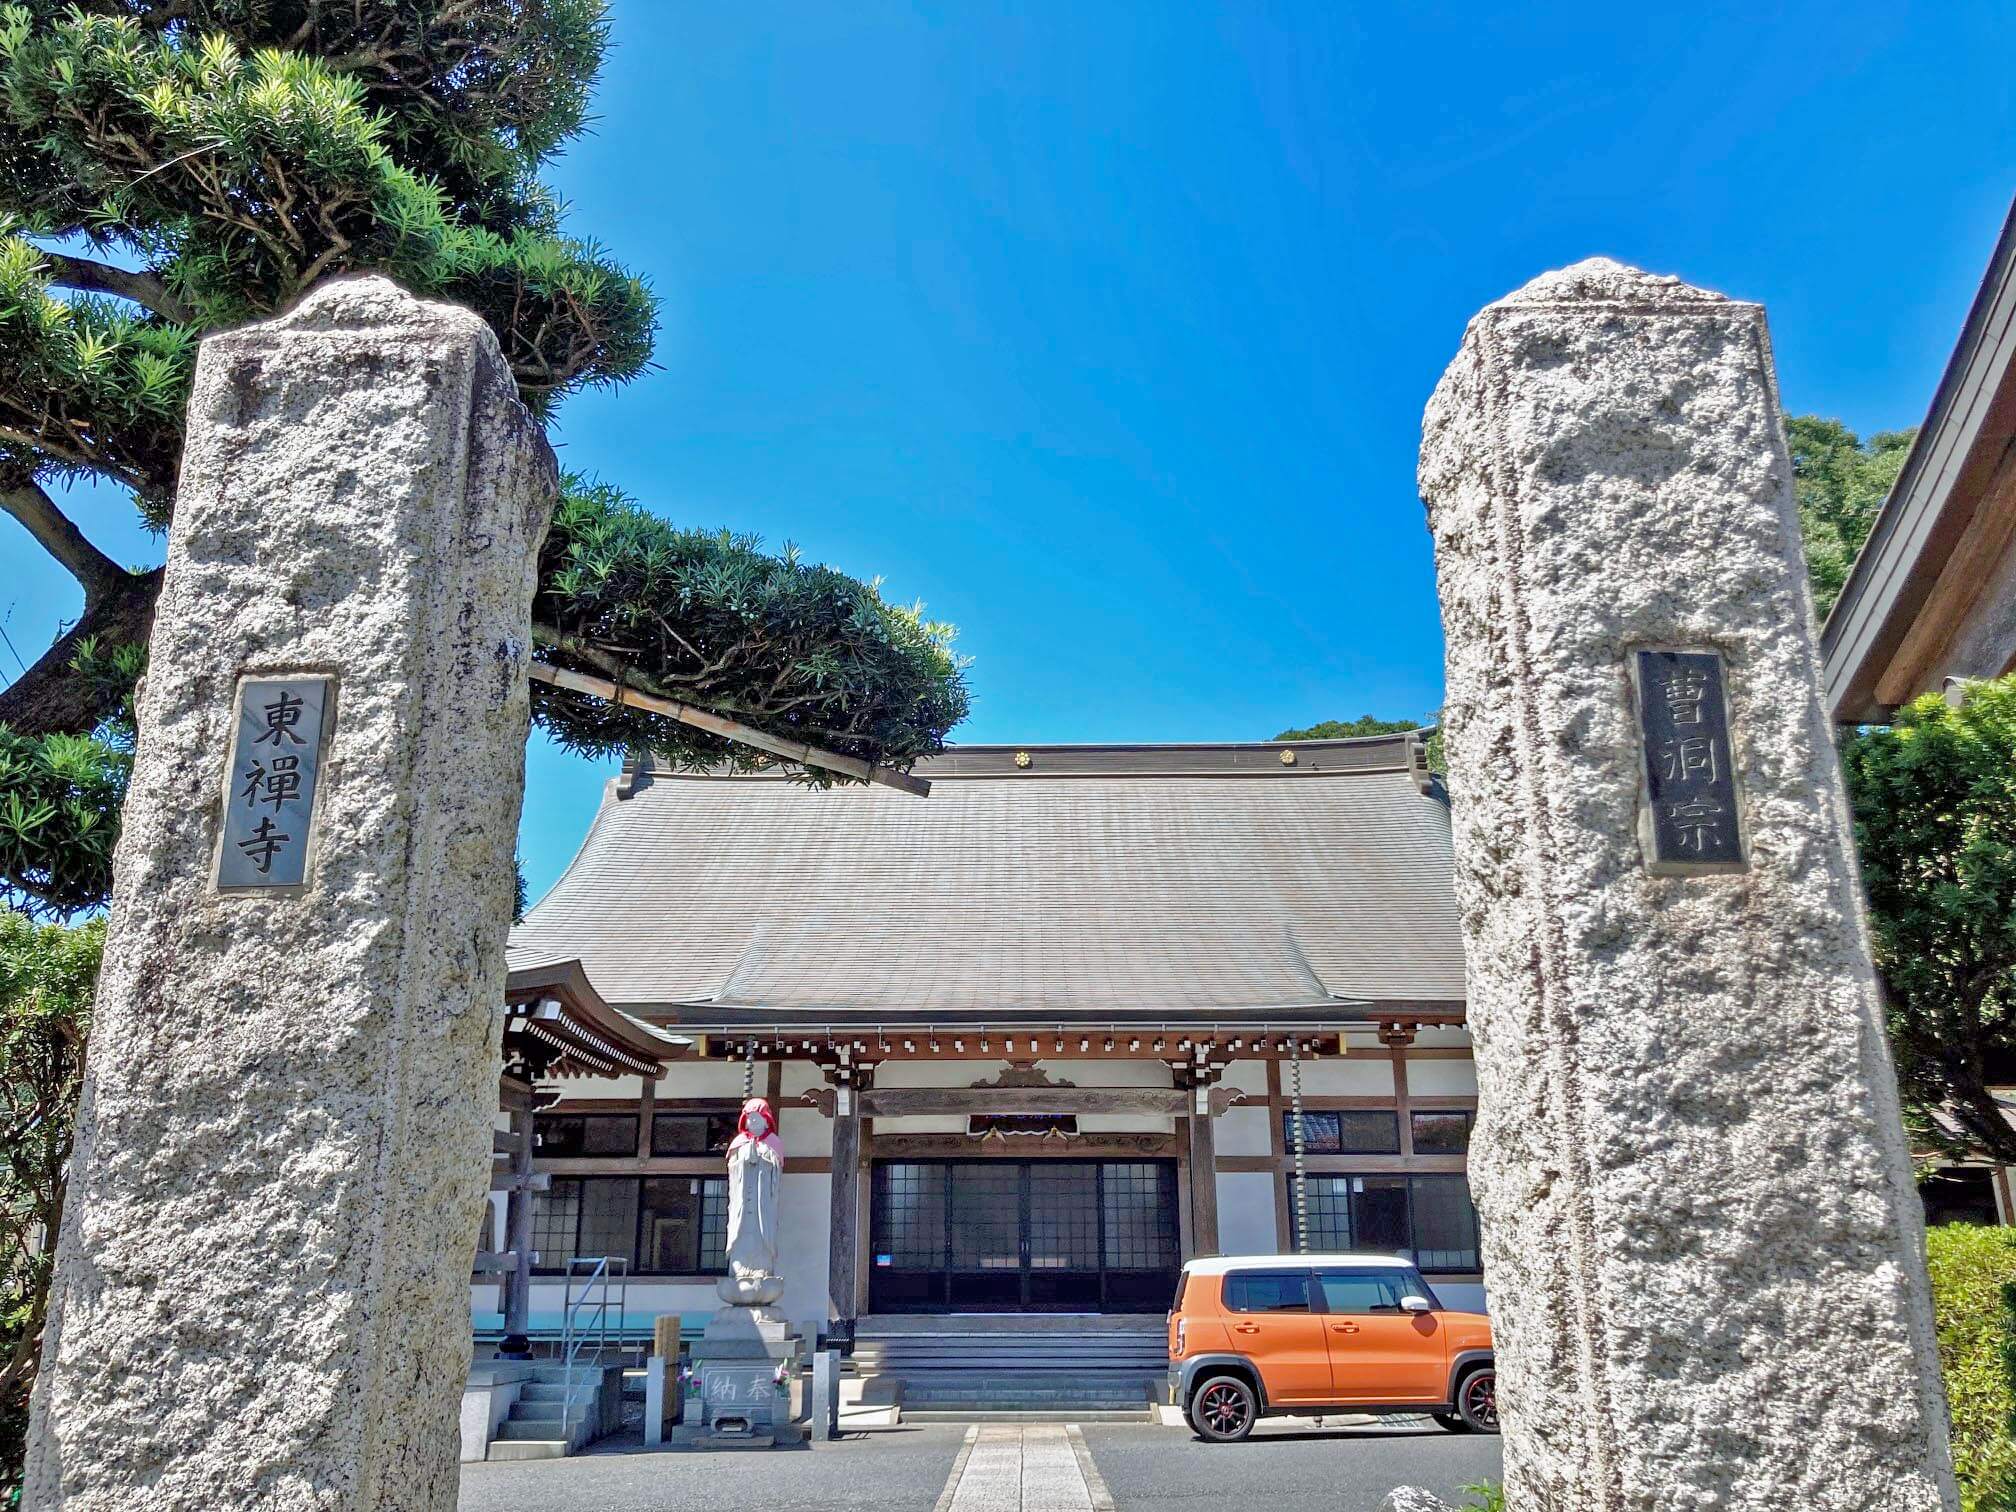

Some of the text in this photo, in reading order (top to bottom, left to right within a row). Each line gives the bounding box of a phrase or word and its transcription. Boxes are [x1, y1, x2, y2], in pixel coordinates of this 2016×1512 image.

[237, 690, 308, 874] 東禪寺
[1657, 668, 1722, 851] 曹洞宗
